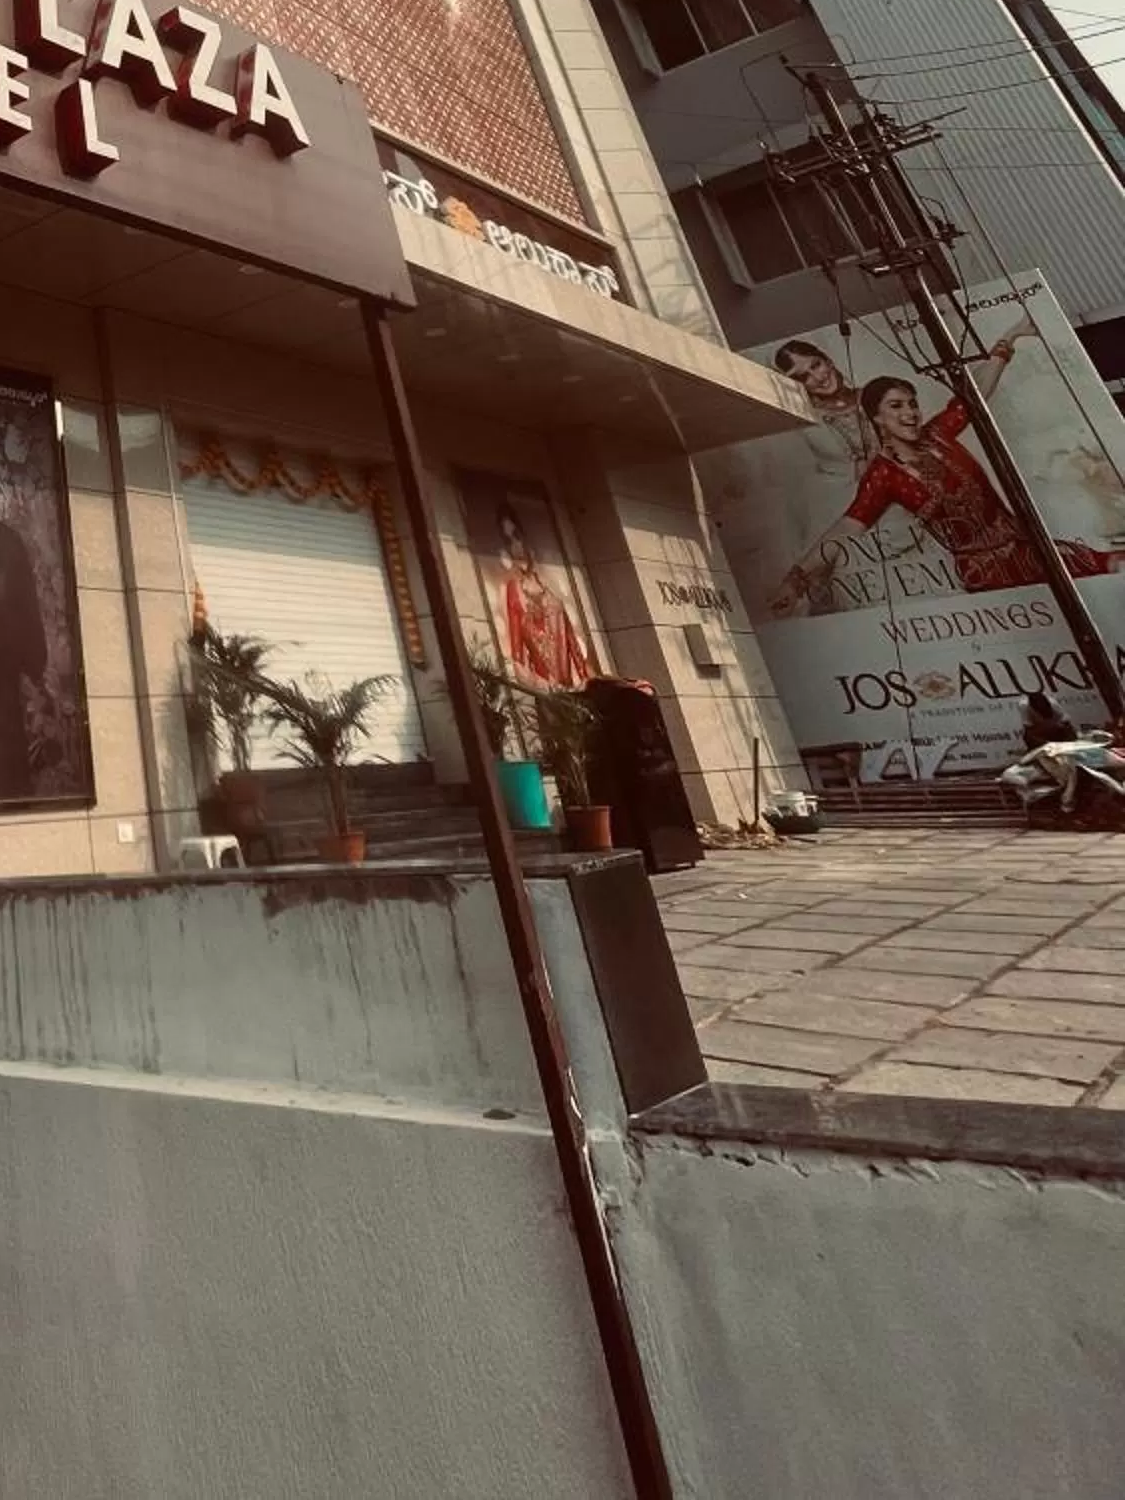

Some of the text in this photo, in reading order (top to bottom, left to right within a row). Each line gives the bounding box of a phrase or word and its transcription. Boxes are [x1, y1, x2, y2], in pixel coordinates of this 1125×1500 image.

[820, 526, 901, 568] ONE
[881, 601, 1054, 645] WEDDINGS
[835, 669, 917, 715] JOS
